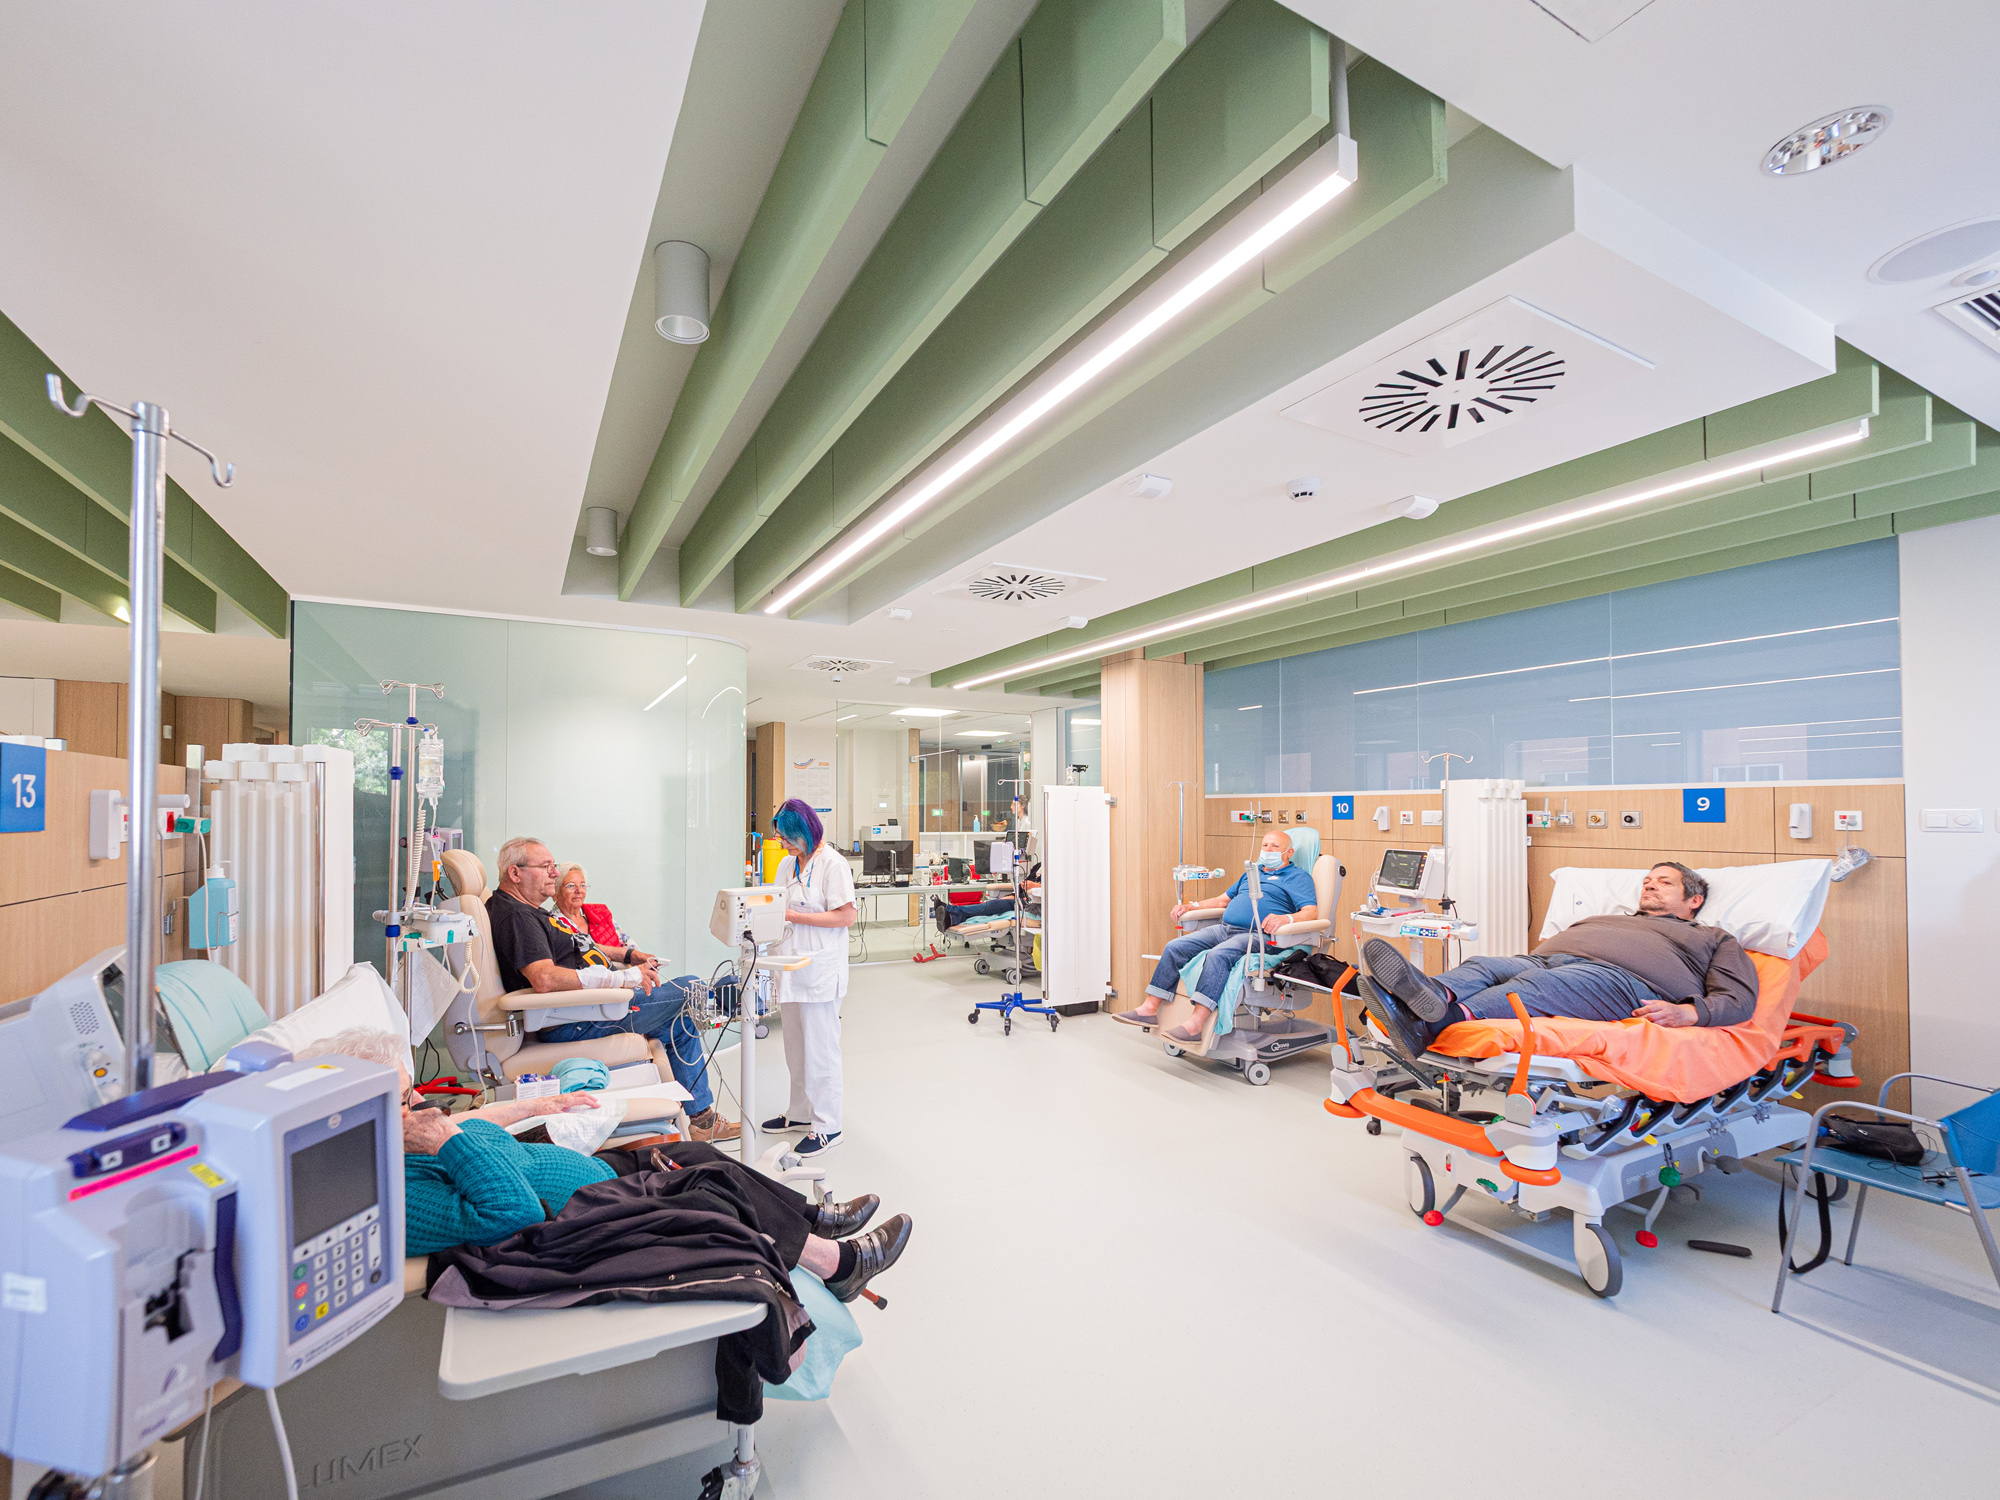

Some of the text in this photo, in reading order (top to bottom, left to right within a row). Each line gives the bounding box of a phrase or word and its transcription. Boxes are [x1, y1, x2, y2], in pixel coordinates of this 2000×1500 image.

[11, 773, 37, 809] 13
[1336, 802, 1349, 814] 10
[1696, 796, 1711, 812] 9
